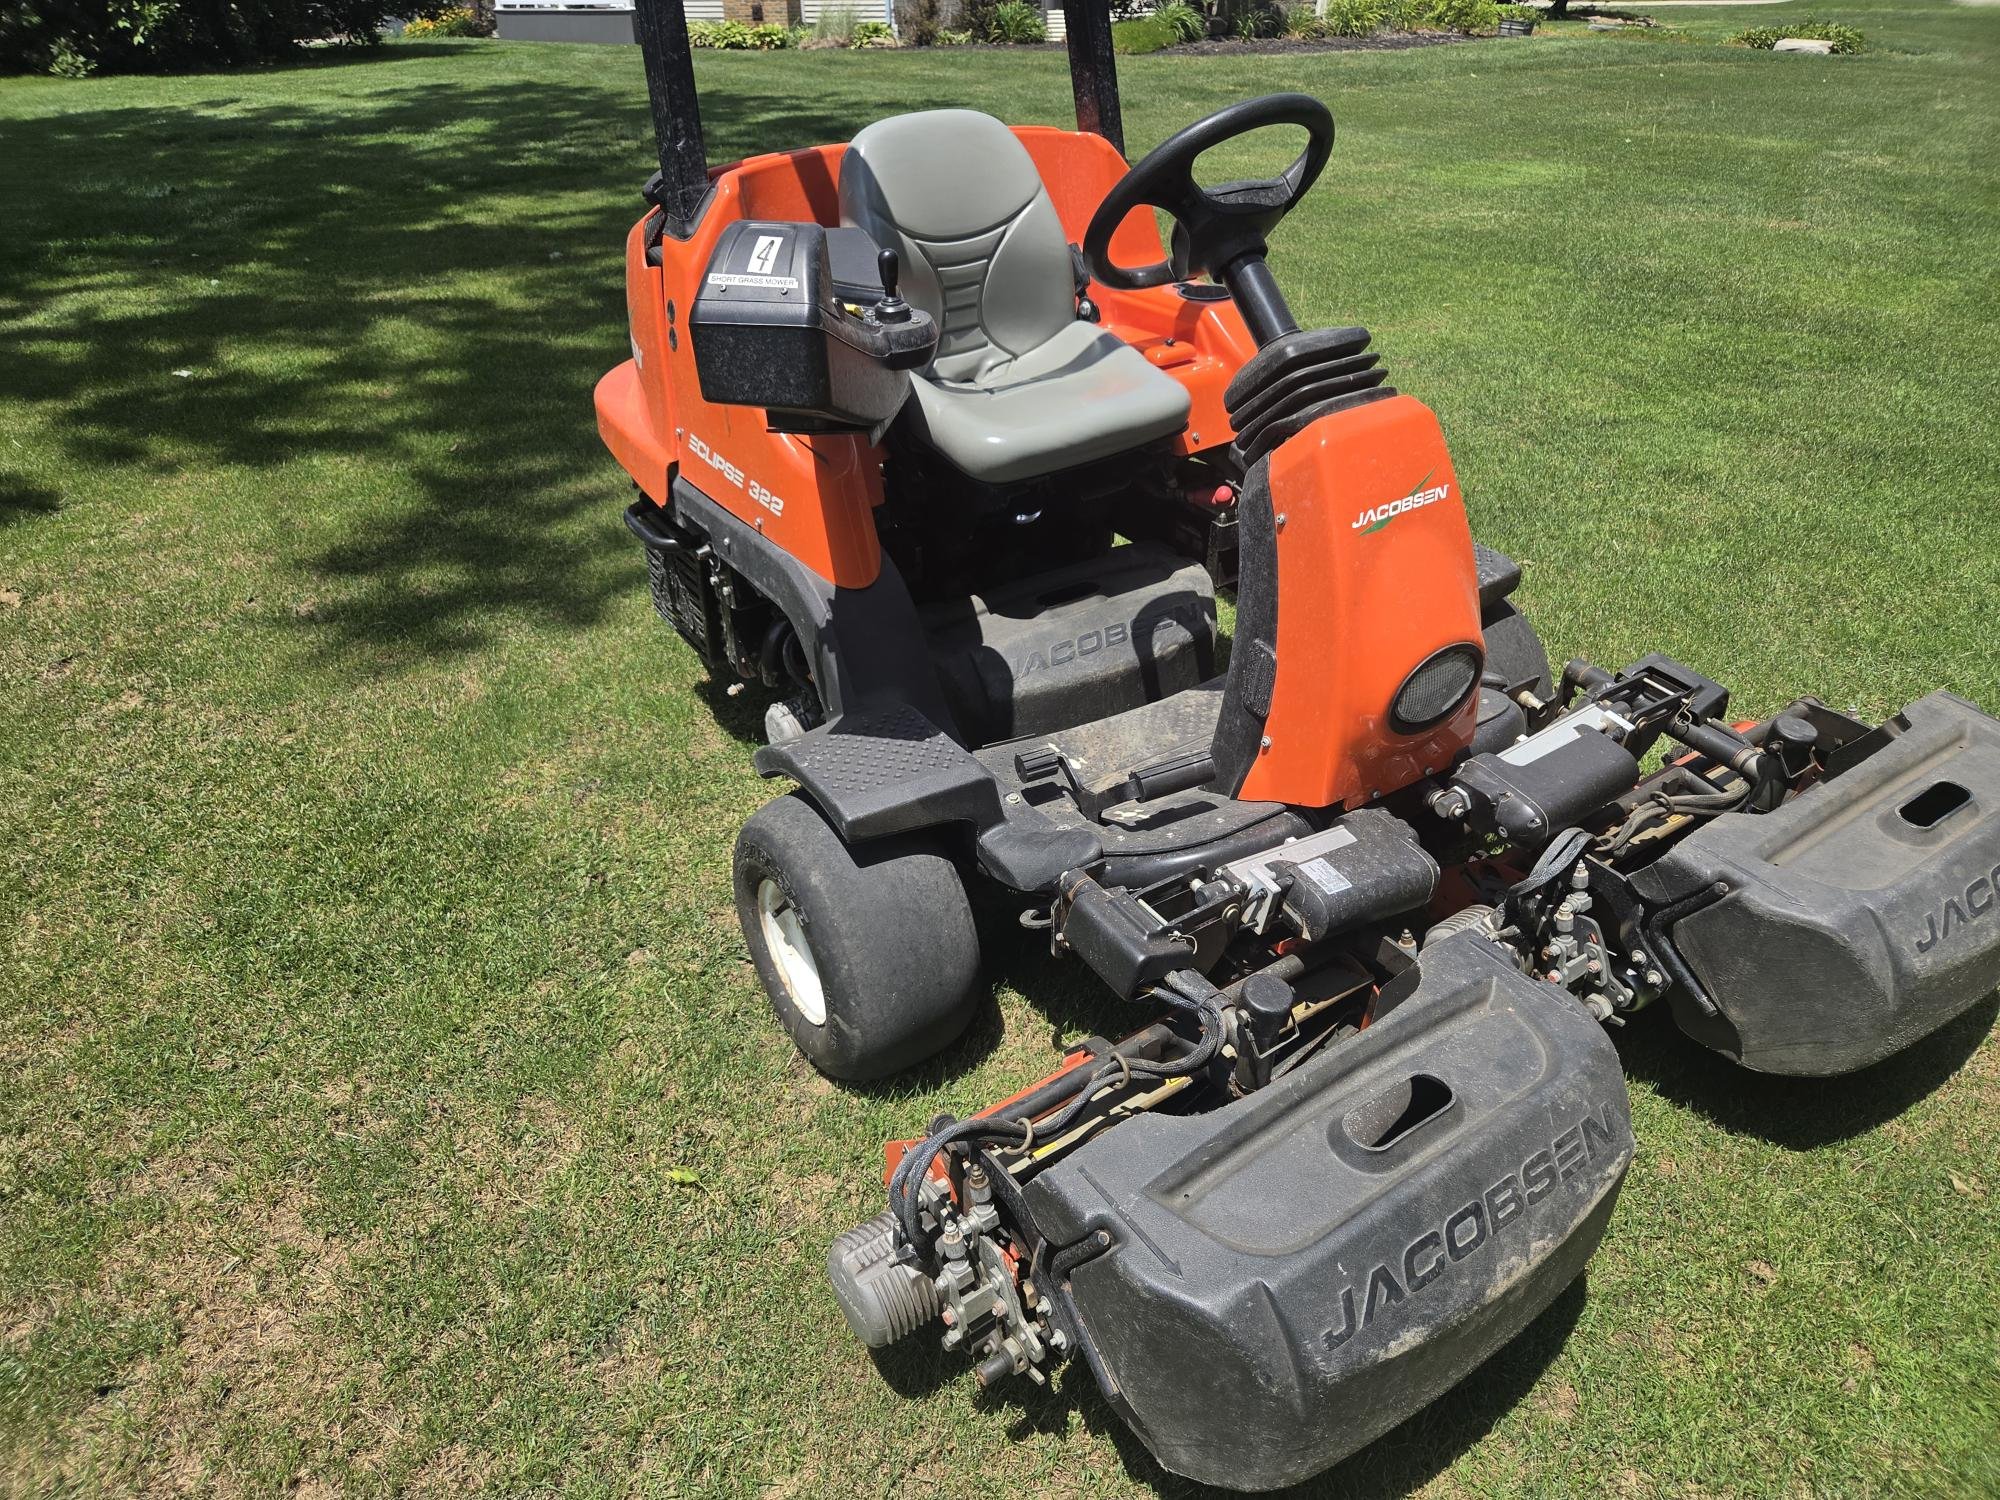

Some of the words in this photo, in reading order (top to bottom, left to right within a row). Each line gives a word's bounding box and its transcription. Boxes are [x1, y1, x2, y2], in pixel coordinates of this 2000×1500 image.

[757, 239, 775, 271] 4
[711, 275, 736, 283] SHORT
[738, 277, 763, 285] GRASS
[765, 278, 795, 286] MOWER
[688, 433, 745, 489] ECLIPSE
[748, 479, 784, 517] 322
[1351, 484, 1450, 529] JACOBSEN
[1320, 1098, 1618, 1351] JACOBSEN
